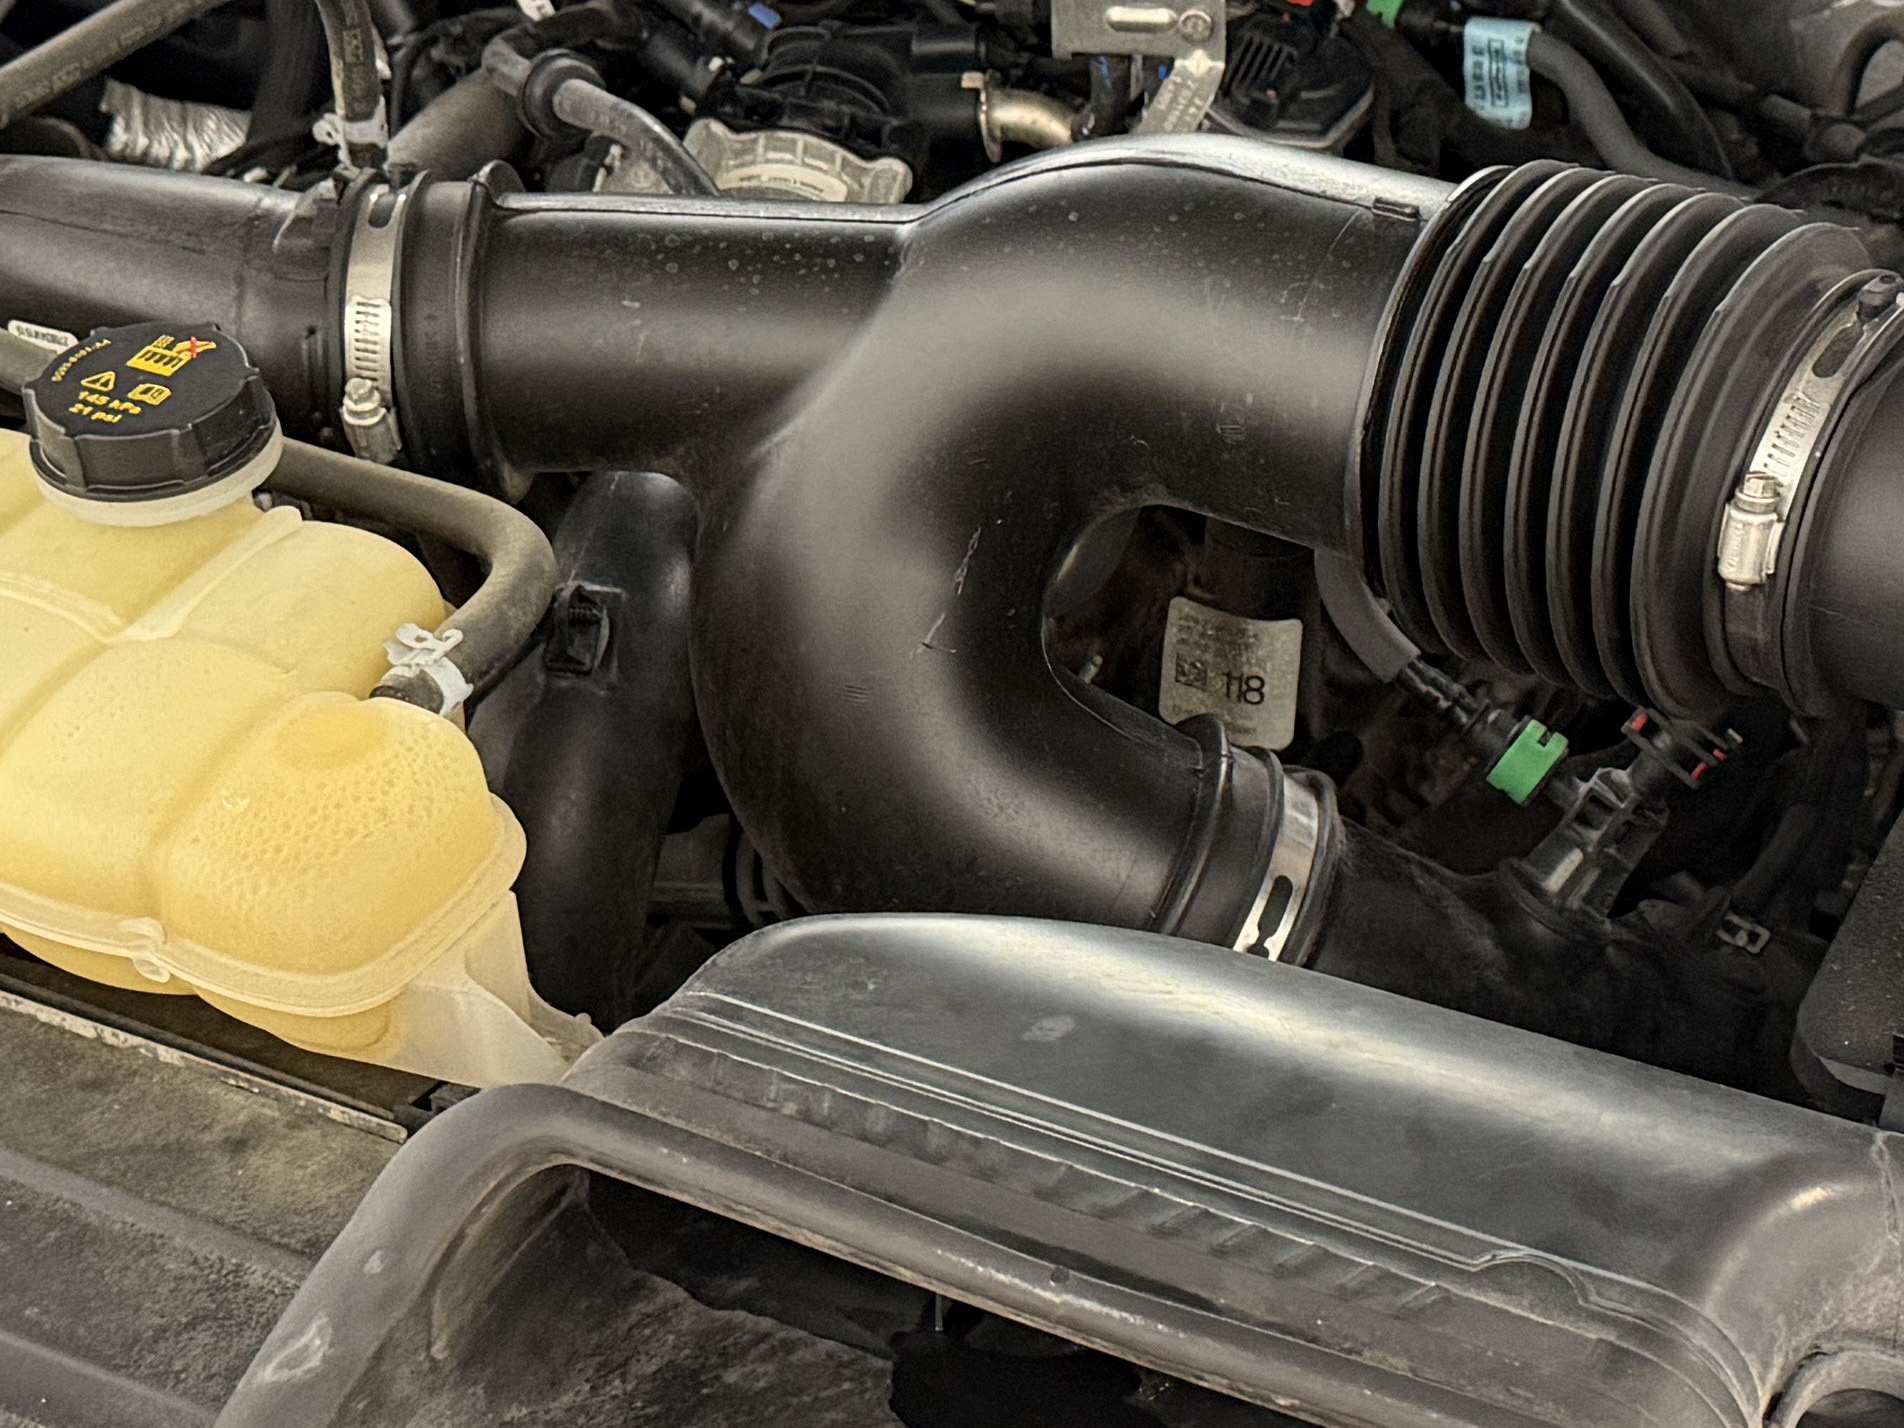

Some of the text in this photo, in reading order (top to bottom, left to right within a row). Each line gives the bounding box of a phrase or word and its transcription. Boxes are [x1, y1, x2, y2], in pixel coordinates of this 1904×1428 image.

[68, 403, 123, 424] 21 psi
[78, 390, 142, 415] 145 kPa
[1222, 671, 1266, 706] 118
